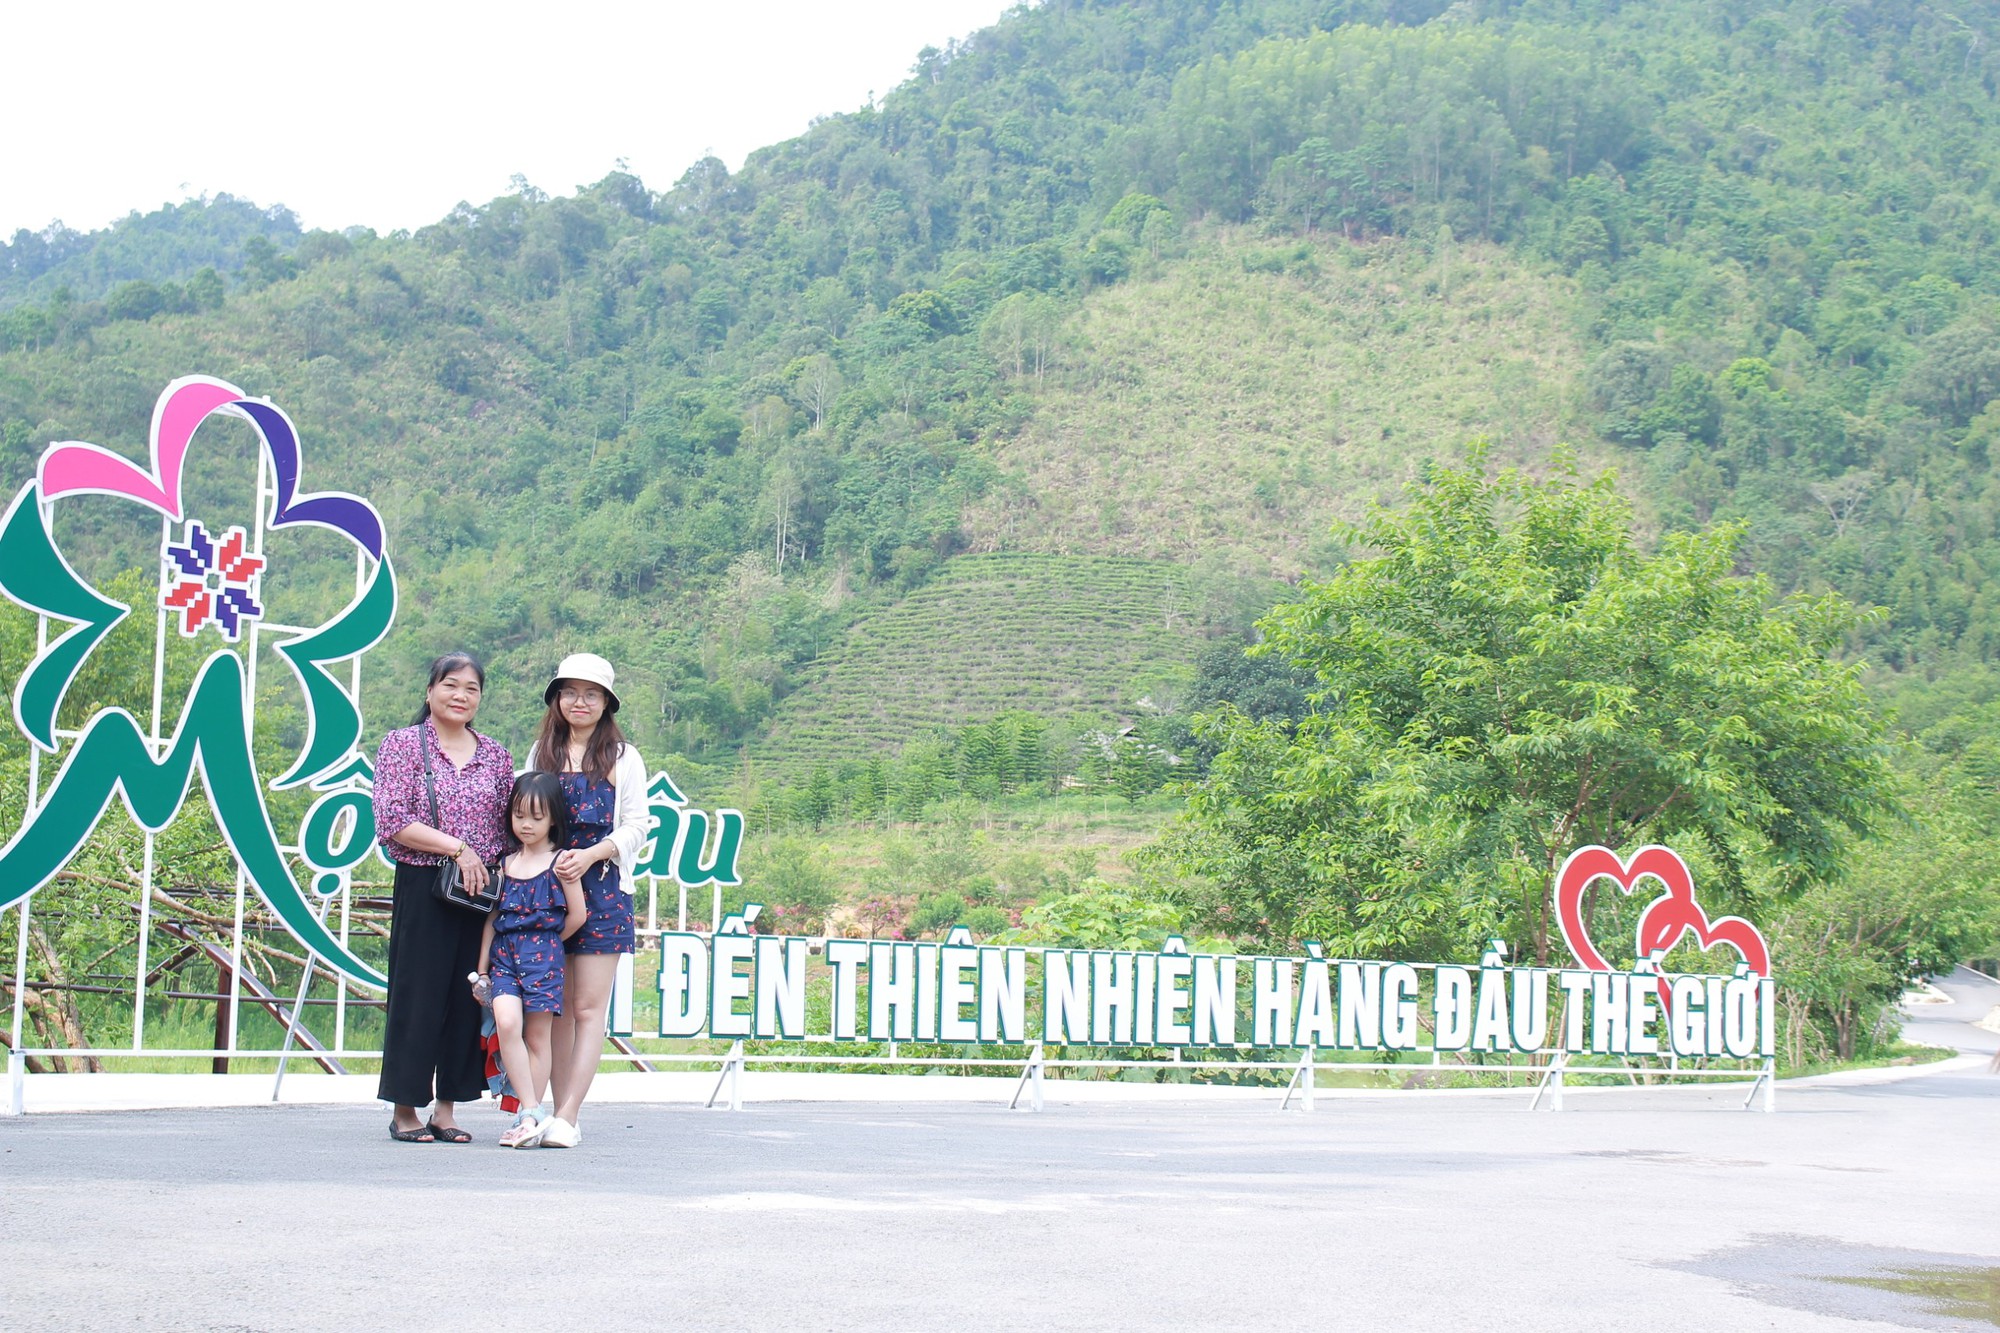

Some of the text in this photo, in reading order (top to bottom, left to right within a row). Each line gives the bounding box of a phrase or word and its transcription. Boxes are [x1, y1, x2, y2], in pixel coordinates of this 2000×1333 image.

[0, 650, 744, 992] Mộ âu
[656, 902, 806, 1040] ĐẾN
[826, 924, 1026, 1045] THIÊN
[1043, 934, 1238, 1048] NHIÊN
[1252, 940, 1419, 1051] HÀNG
[1433, 939, 1548, 1054] ĐẦU
[1560, 948, 1666, 1056] THẾ
[1670, 960, 1775, 1059] GIỚI
